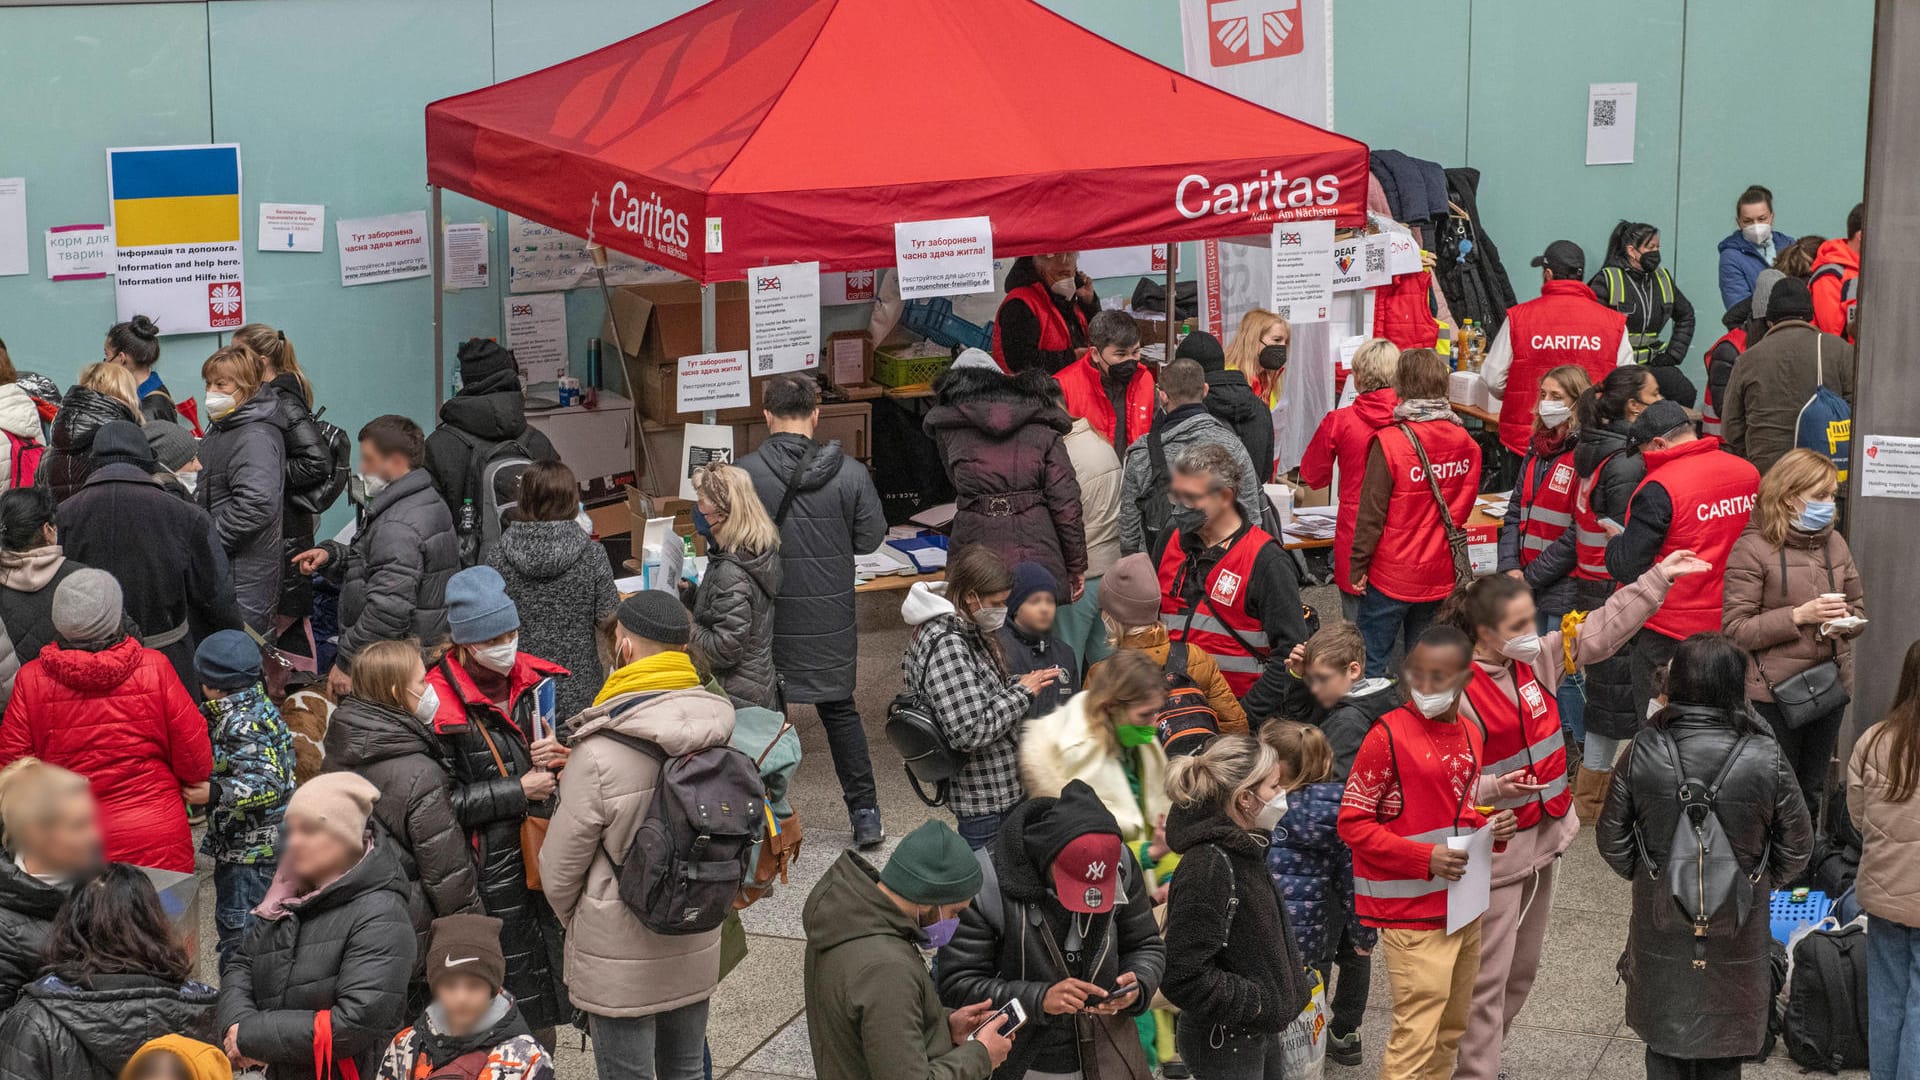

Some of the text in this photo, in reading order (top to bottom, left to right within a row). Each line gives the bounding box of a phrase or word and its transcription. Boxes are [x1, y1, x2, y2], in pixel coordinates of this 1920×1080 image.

[1175, 169, 1340, 219] Caritas
[609, 180, 689, 248] Caritas
[1278, 210, 1294, 219] Am
[1295, 207, 1339, 218] Nächsten
[50, 235, 110, 248] корм для
[352, 228, 413, 242] Тут заборонена
[394, 236, 422, 247] житла!
[911, 235, 977, 250] Тут заборонена
[58, 250, 104, 262] тварин
[187, 245, 237, 254] допомога.
[902, 246, 986, 260] часна здача житла!
[1334, 246, 1357, 258] DEAF
[117, 263, 172, 272] Information
[194, 259, 215, 268] help
[217, 258, 241, 266] here.
[118, 272, 240, 286] Information und Hilfe hier.
[945, 272, 957, 281] для
[1332, 276, 1361, 285] REFUGEES
[902, 279, 990, 292] www.muenchner-freiwillige.de
[212, 316, 241, 327] caritas
[1531, 335, 1601, 350] CARITAS
[699, 357, 737, 367] заборонена
[1085, 860, 1106, 881] NY
